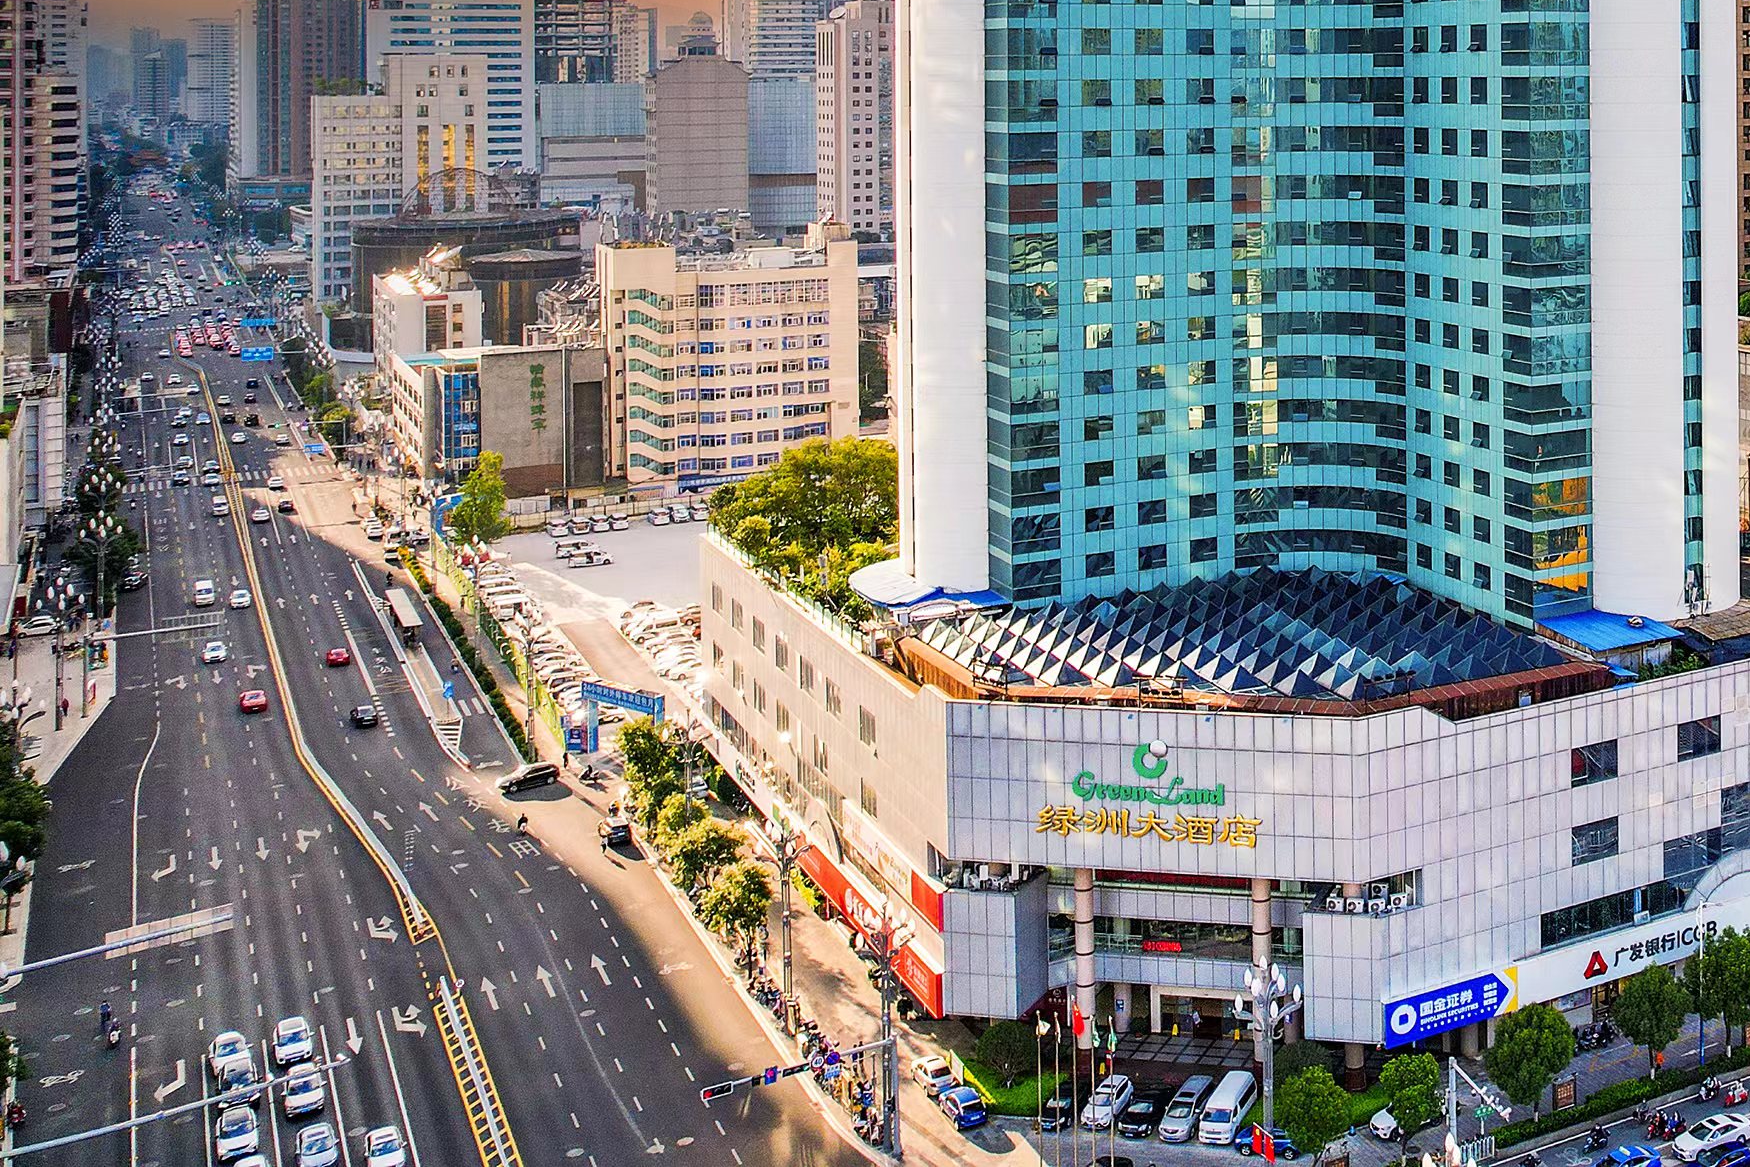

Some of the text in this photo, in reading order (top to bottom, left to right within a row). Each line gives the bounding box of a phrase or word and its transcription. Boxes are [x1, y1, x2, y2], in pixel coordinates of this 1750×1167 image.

[1034, 803, 1263, 849] 绿洲大酒店
[1419, 989, 1474, 1018] 国金证券
[1447, 1002, 1480, 1018] SECURITIES
